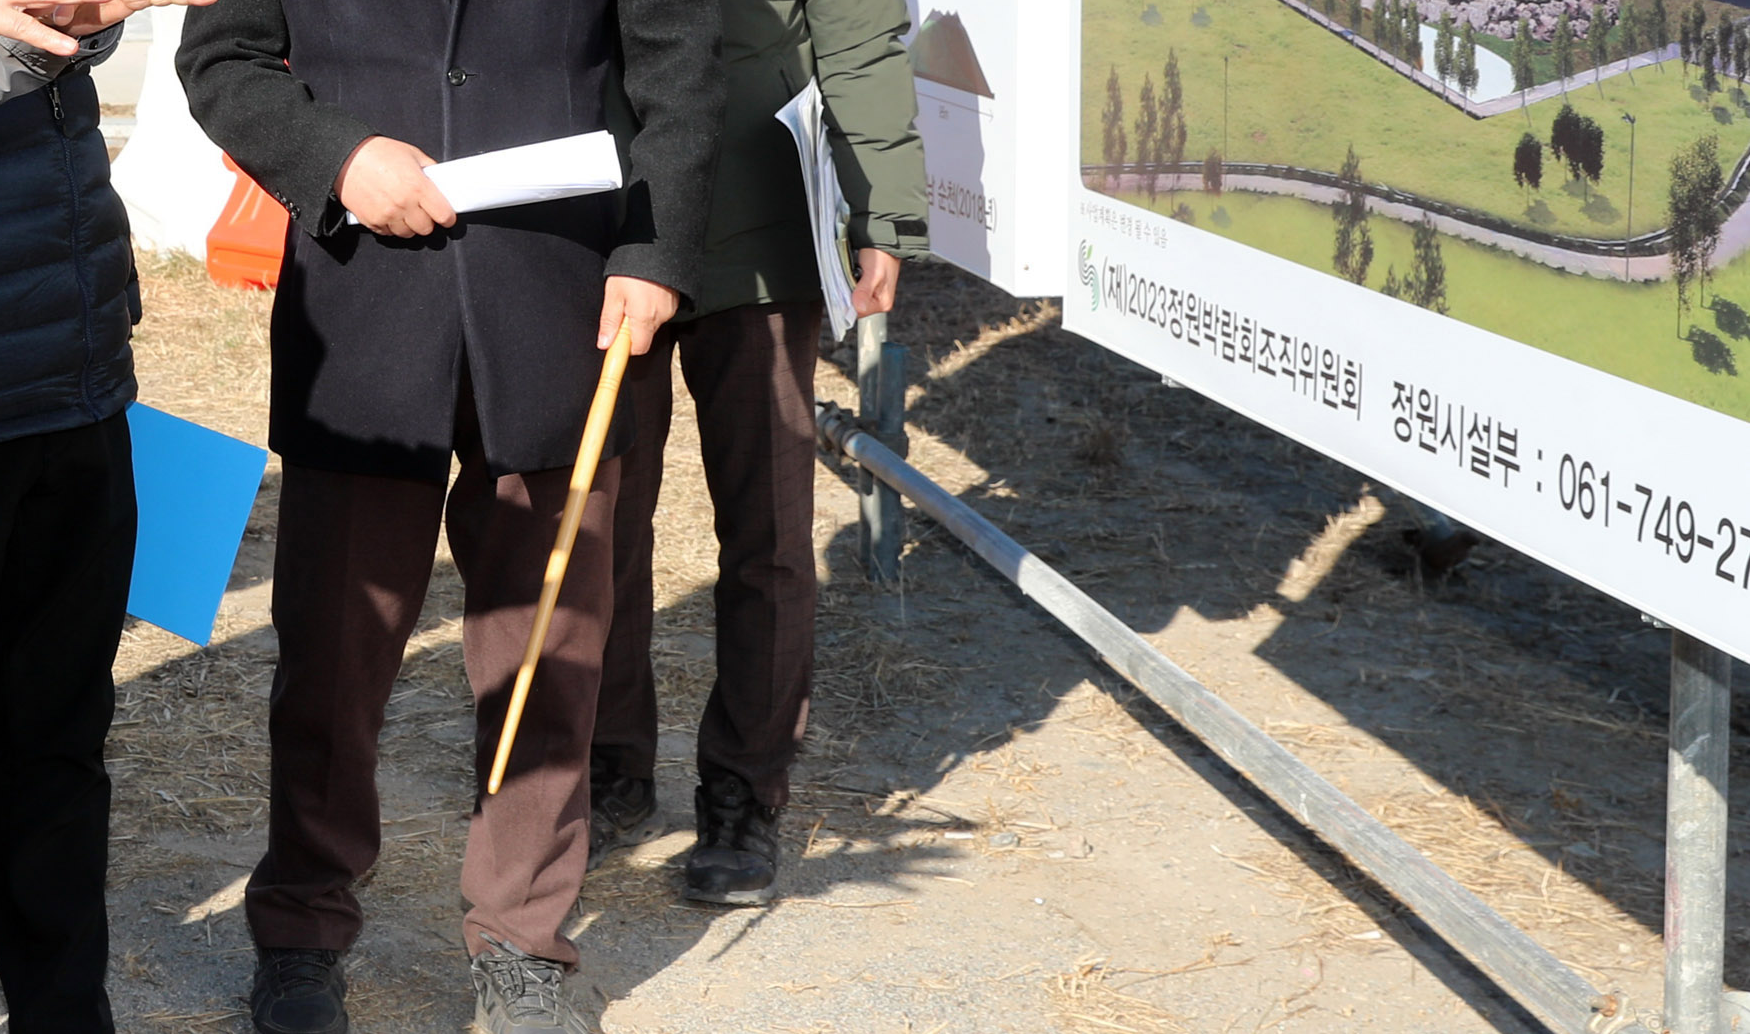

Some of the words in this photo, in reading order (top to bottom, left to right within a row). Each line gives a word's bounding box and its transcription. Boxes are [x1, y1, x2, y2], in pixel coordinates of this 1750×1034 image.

[938, 178, 997, 234] 순천(2018년)
[1102, 256, 1363, 421] (재)2023정원박람회조직위원회
[1391, 380, 1521, 488] 정원시설부
